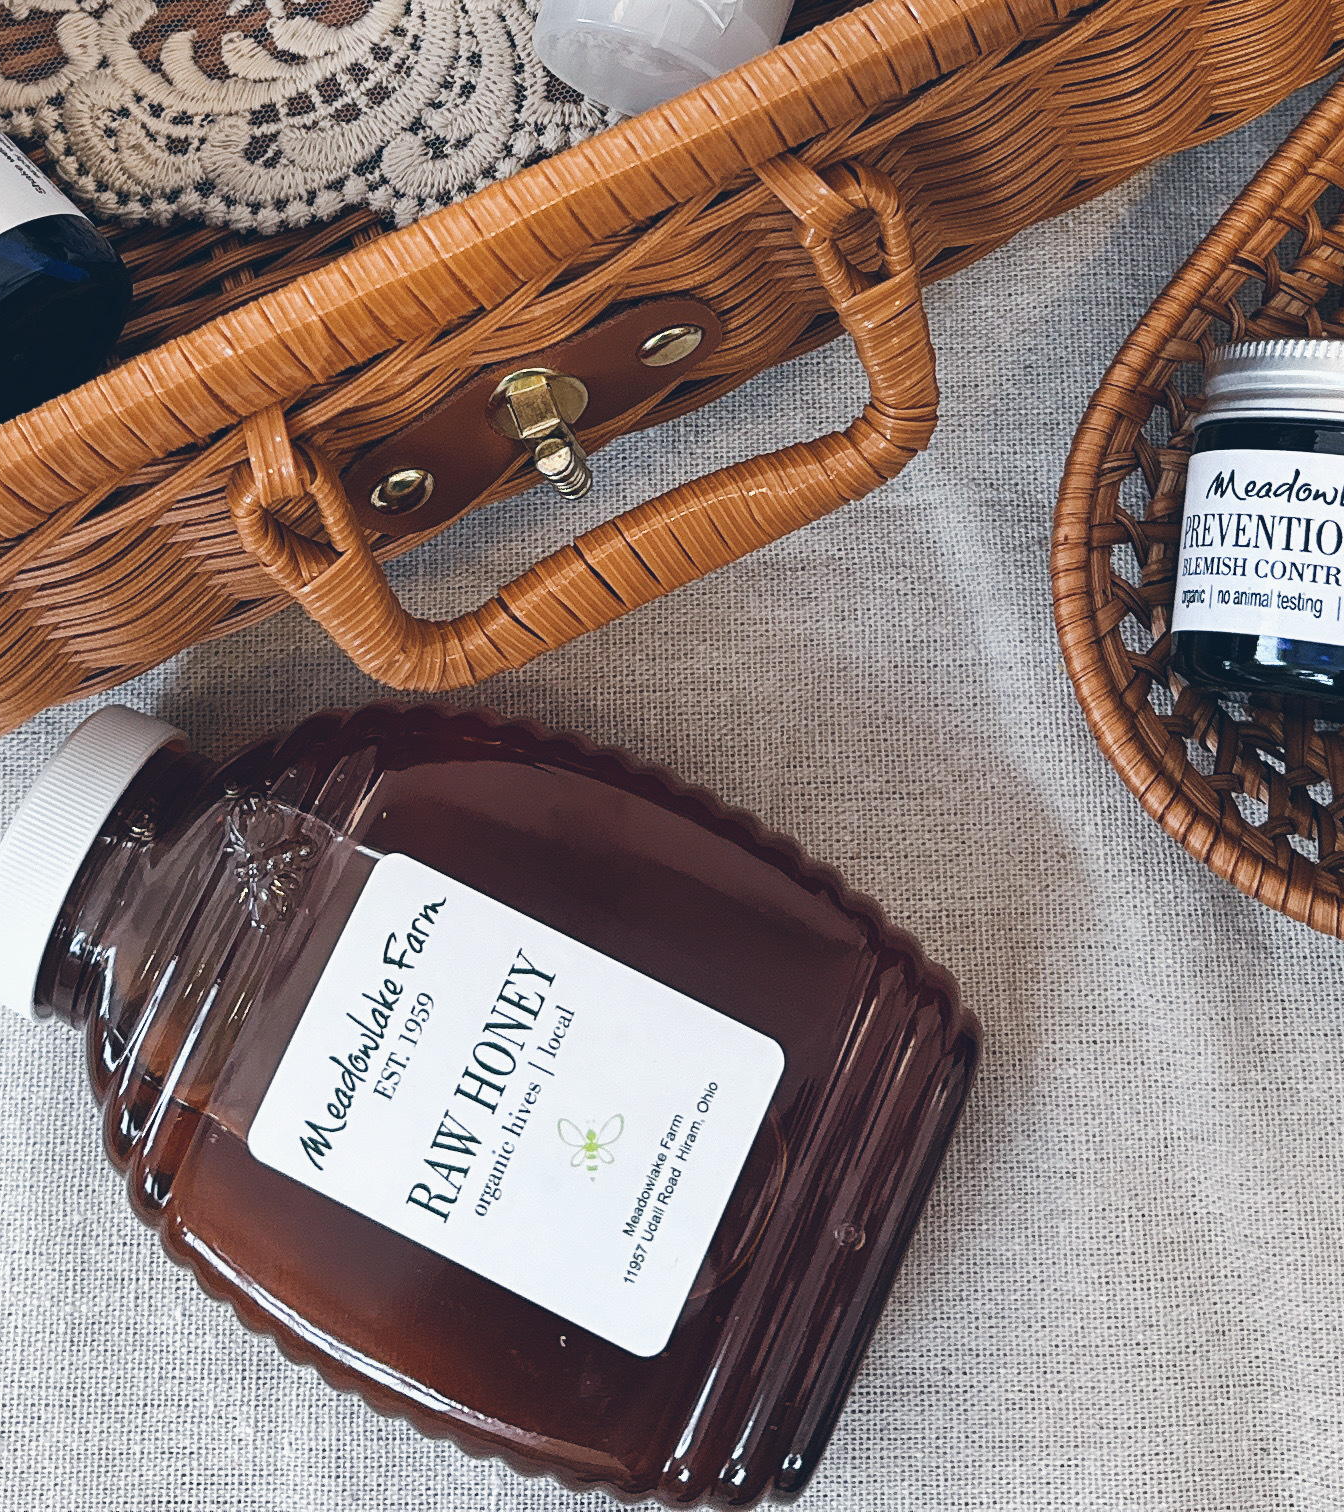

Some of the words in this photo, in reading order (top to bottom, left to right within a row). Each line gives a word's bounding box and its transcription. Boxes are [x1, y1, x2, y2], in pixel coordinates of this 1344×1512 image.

[1180, 588, 1206, 609] organic
[1216, 589, 1231, 606] no
[1232, 589, 1273, 608] animal
[1276, 591, 1324, 619] testing
[1181, 555, 1248, 577] BLEMISH
[298, 978, 404, 1172] Meadowlake
[382, 896, 447, 970] Farm
[372, 1051, 411, 1101] EST.
[398, 992, 435, 1046] 1959
[405, 1108, 483, 1224] RAW
[452, 947, 557, 1116] HONEY
[474, 1140, 515, 1217] organic
[500, 1081, 542, 1138] hives
[536, 1004, 575, 1059] local
[621, 1152, 668, 1237] Meadowlake
[659, 1113, 684, 1151] Farm
[622, 1243, 648, 1284] 11957
[640, 1205, 665, 1243] Udall
[656, 1166, 682, 1206] Road
[674, 1120, 702, 1162] Hiram,
[696, 1081, 719, 1114] Ohio
